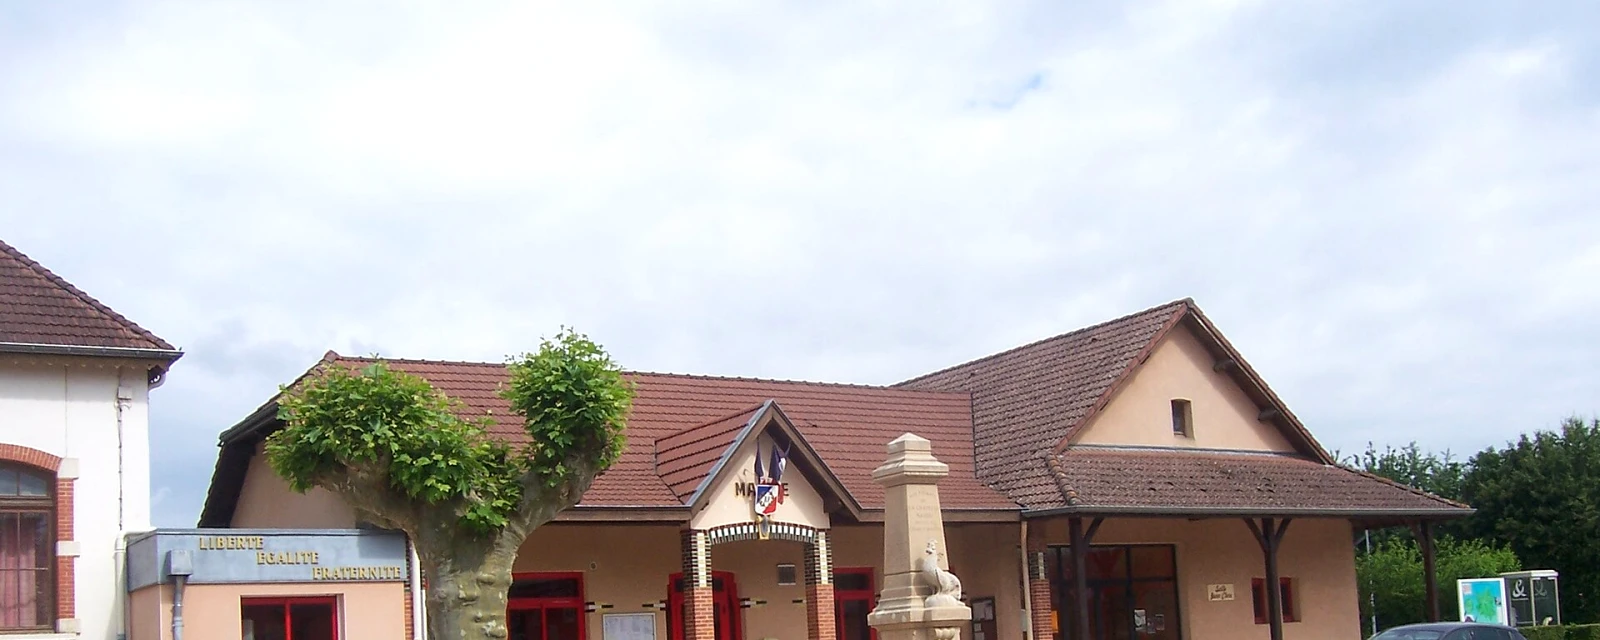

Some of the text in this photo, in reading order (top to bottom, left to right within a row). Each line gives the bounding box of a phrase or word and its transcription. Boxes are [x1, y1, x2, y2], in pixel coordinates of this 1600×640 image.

[735, 482, 789, 497] MAE
[199, 535, 263, 550] LIBERTE
[257, 549, 318, 565] EGALITE
[312, 565, 401, 581] FRATERNITE
